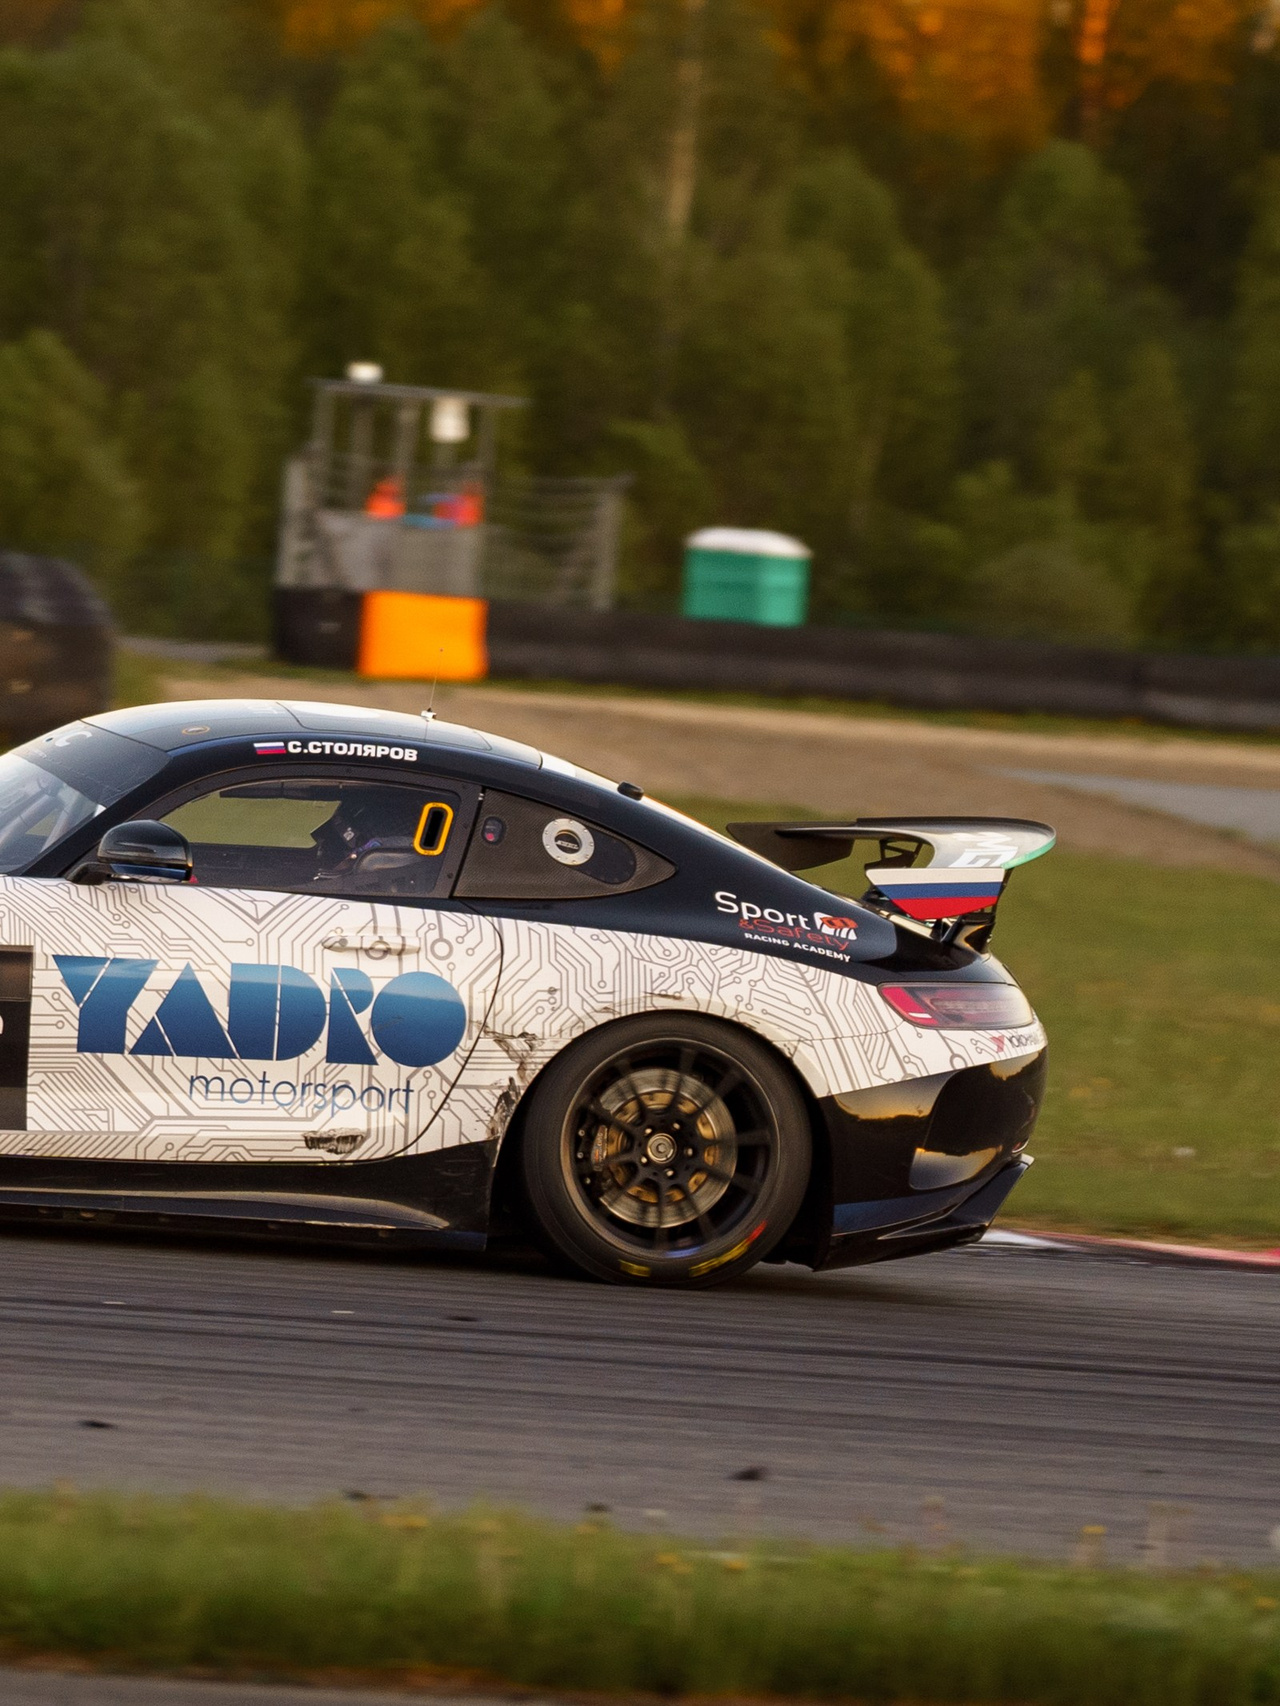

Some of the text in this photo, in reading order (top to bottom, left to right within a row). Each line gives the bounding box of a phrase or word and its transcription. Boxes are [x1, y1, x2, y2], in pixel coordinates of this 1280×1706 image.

[287, 741, 418, 761] С.СТОЛЯРОВ
[714, 891, 812, 931] Sport
[738, 917, 850, 951] &Safety
[744, 932, 852, 963] RACING ACADEMY
[51, 954, 467, 1068] YADRO
[189, 1070, 415, 1117] motorsport
